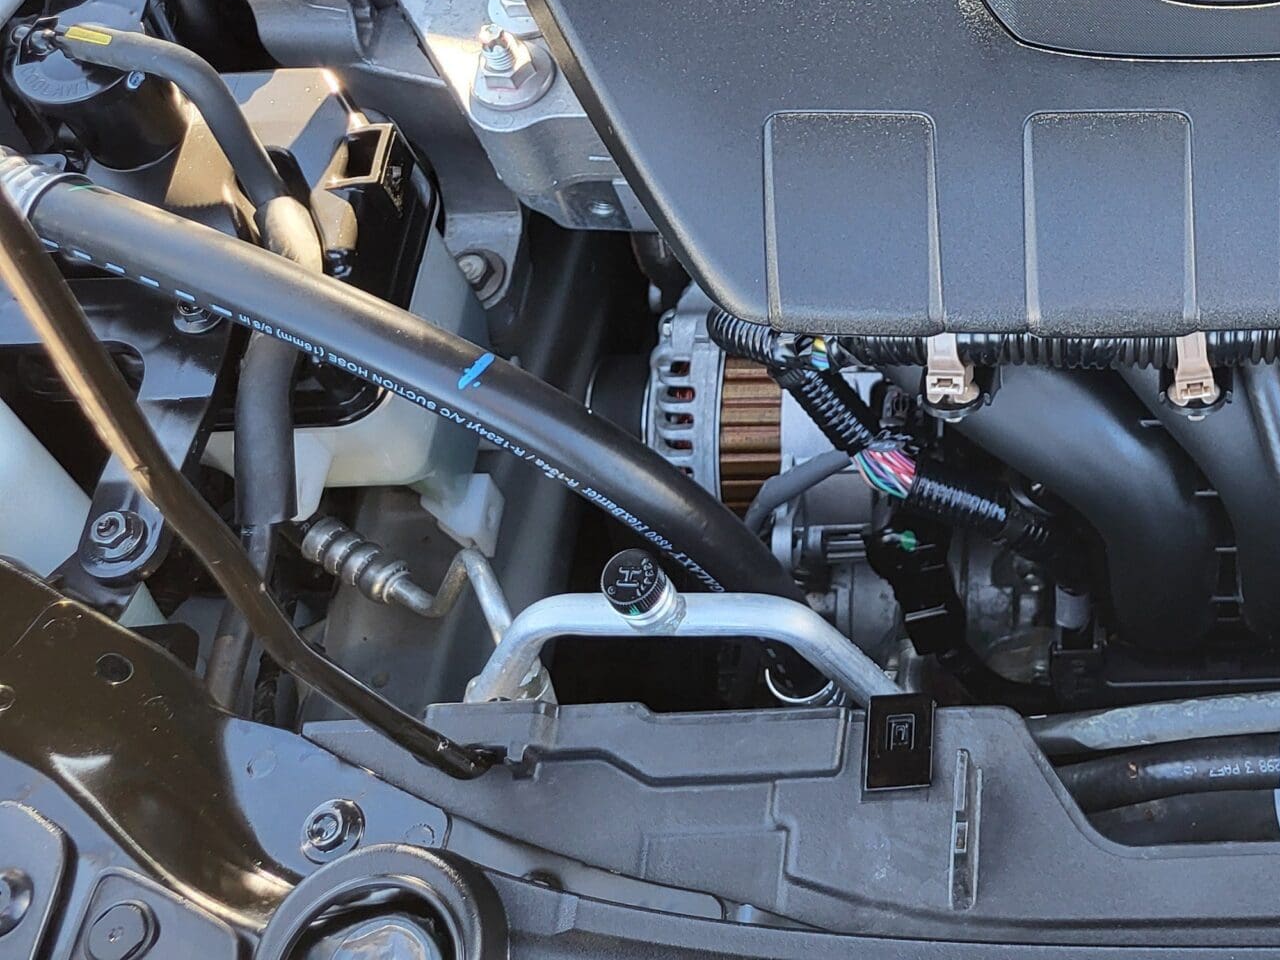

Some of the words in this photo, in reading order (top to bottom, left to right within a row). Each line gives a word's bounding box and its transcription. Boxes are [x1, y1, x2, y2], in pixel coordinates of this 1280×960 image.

[252, 320, 274, 333] 5/8
[277, 328, 325, 357] (16mm)
[327, 351, 369, 378] HOSE
[372, 373, 437, 412] SUCTION
[439, 407, 466, 425] A/C
[467, 420, 526, 457] R-1234yf
[582, 486, 649, 534] FlexBarrier
[667, 550, 725, 593] GALAXY
